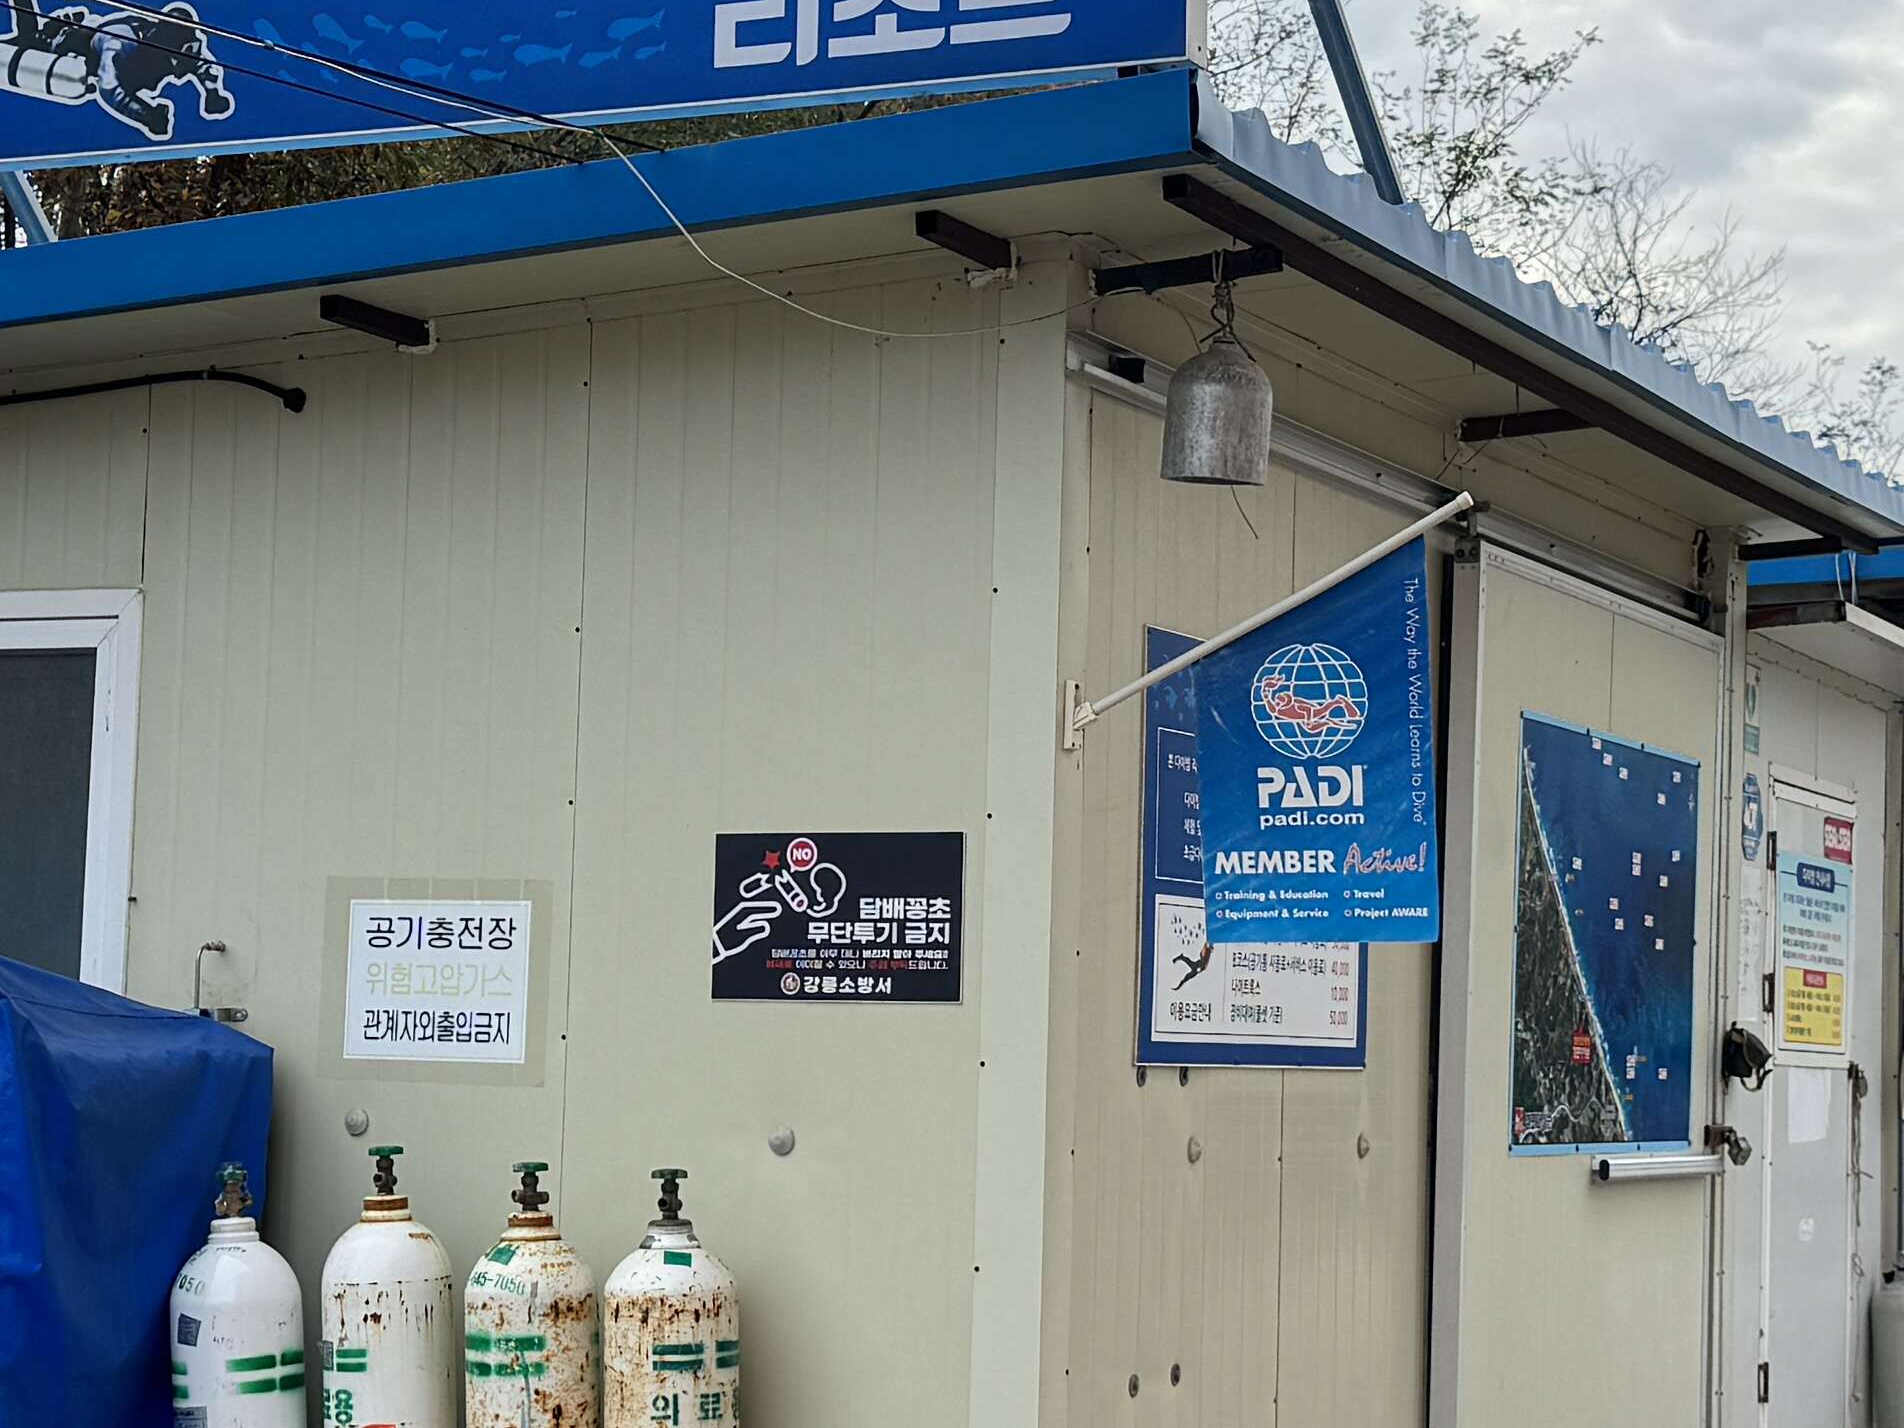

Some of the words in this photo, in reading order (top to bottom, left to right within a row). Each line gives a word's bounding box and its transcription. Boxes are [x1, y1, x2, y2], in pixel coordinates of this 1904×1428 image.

[1403, 577, 1419, 603] The
[1403, 607, 1420, 643] Way
[1407, 648, 1422, 670] the
[1409, 674, 1424, 719] World
[1410, 724, 1424, 769] Learns
[1257, 765, 1364, 808] PADI
[1412, 774, 1423, 786] to
[1412, 791, 1426, 823] Dive
[1260, 811, 1365, 830] padi.com
[793, 849, 812, 861] NO
[1214, 850, 1337, 874] MEMBER
[1343, 842, 1427, 874] Active!
[1224, 890, 1266, 901] Training
[1269, 890, 1277, 899] &
[1279, 890, 1329, 900] Education
[1354, 888, 1385, 898] Travel
[859, 897, 952, 920] 담배꽁초
[1225, 910, 1278, 920] Equipment
[1281, 910, 1289, 918] &
[1292, 909, 1329, 918] Service
[1354, 908, 1388, 918] Project
[1391, 908, 1428, 917] AWARE
[366, 916, 517, 950] 공기충전장
[807, 922, 897, 944] 무단투기
[905, 922, 951, 944] 금지
[366, 962, 512, 997] 위험고압가스
[803, 976, 892, 994] 강릉소방서
[363, 1009, 511, 1044] 관계자외출입금지
